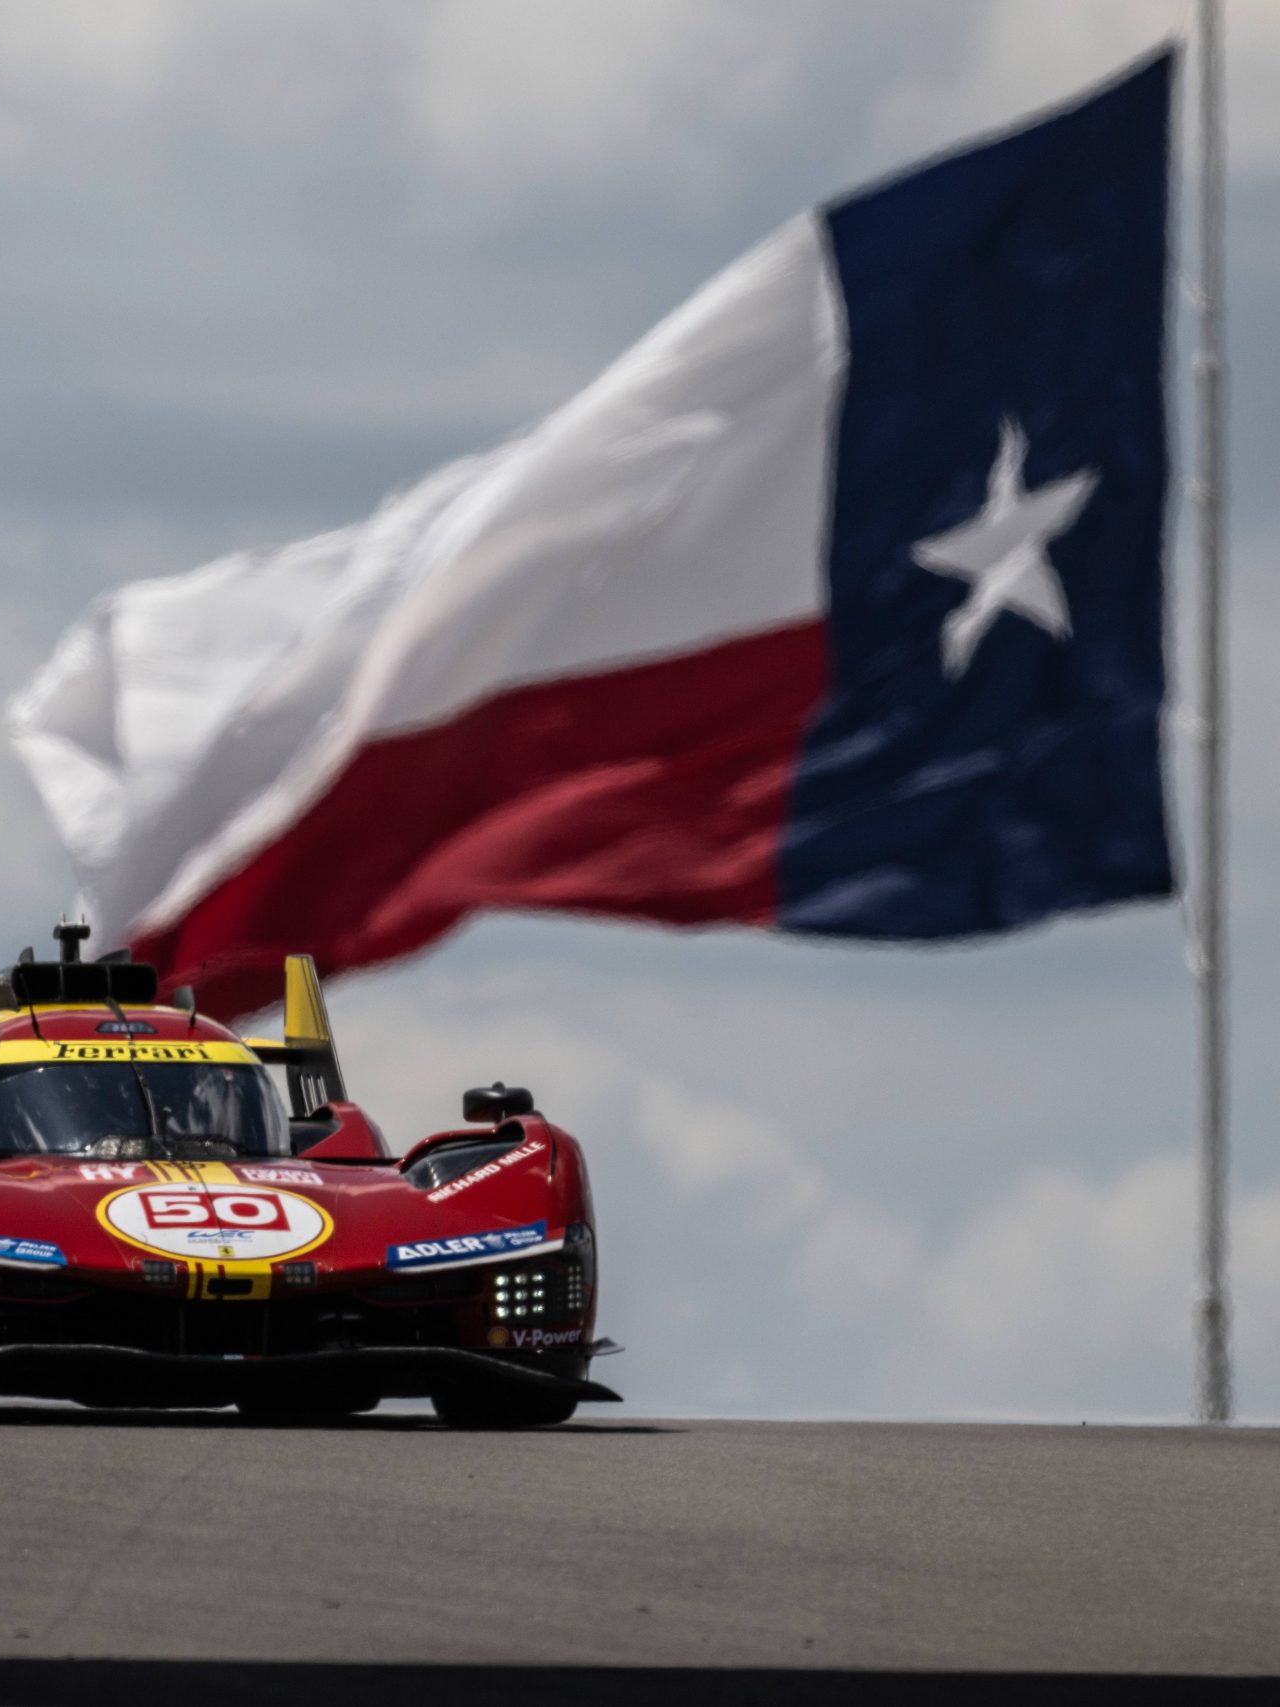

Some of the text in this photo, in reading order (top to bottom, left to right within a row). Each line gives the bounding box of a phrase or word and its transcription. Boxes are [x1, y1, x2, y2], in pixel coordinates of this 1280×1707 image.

[53, 1042, 213, 1060] Ferrari
[427, 1141, 545, 1203] RICHARD MILLE
[147, 1194, 279, 1226] 50
[398, 1237, 485, 1260] ADLER
[512, 1328, 582, 1347] V-Power
